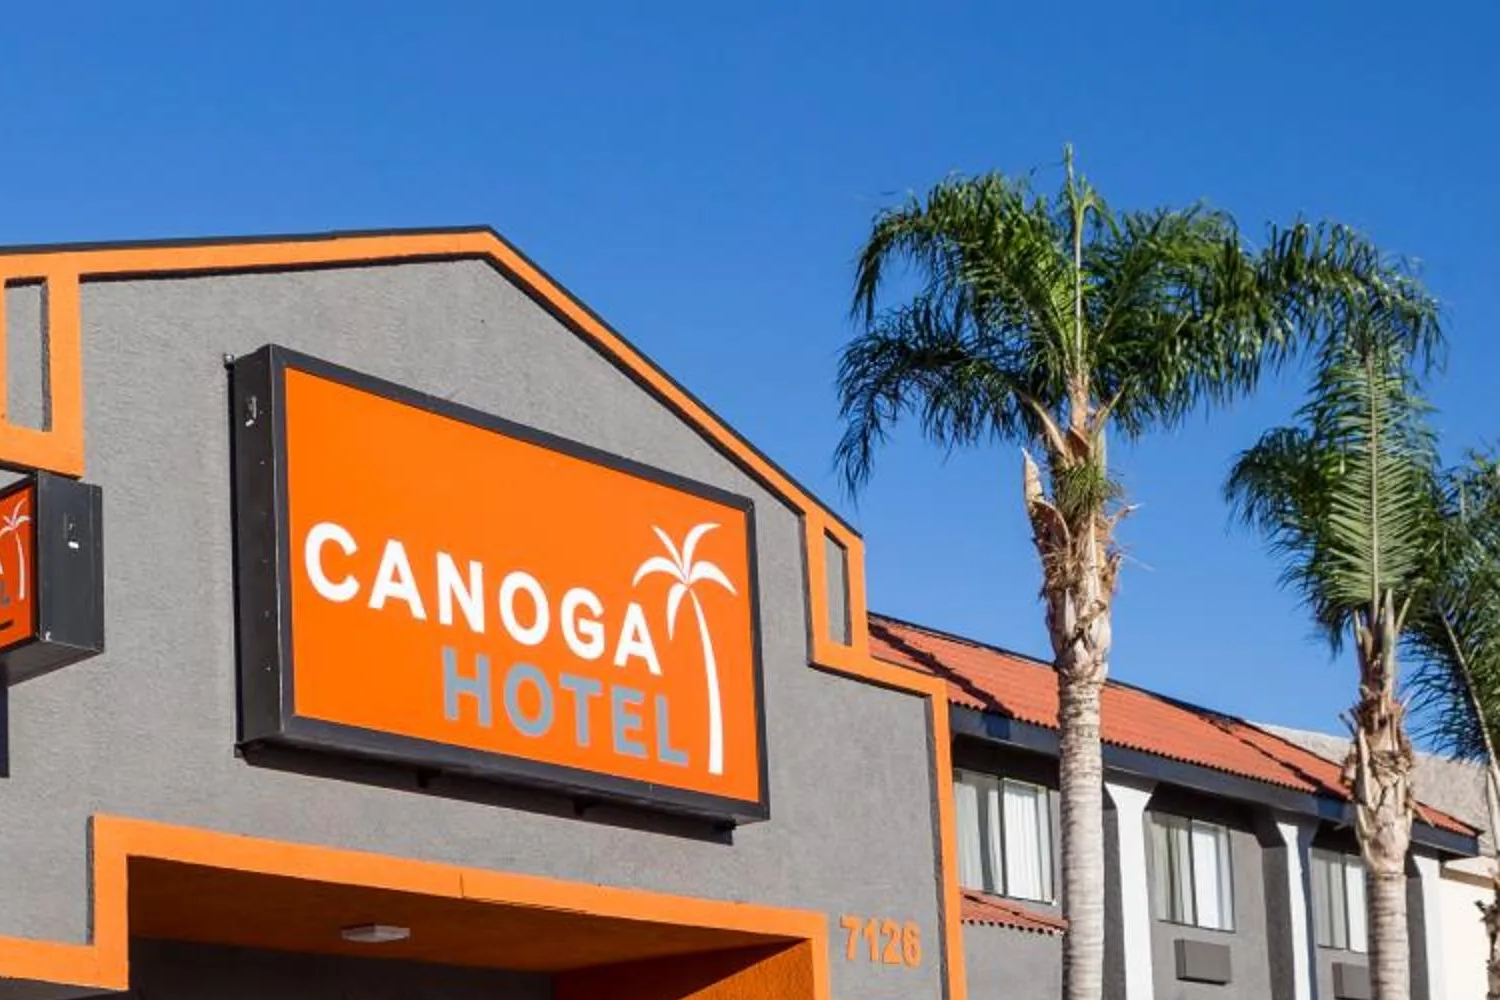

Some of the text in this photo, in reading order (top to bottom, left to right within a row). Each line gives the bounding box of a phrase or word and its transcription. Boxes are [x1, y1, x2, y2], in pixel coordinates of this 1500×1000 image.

[305, 522, 661, 675] CANOGA
[443, 647, 688, 766] HOTEL
[839, 914, 922, 968] 7126
